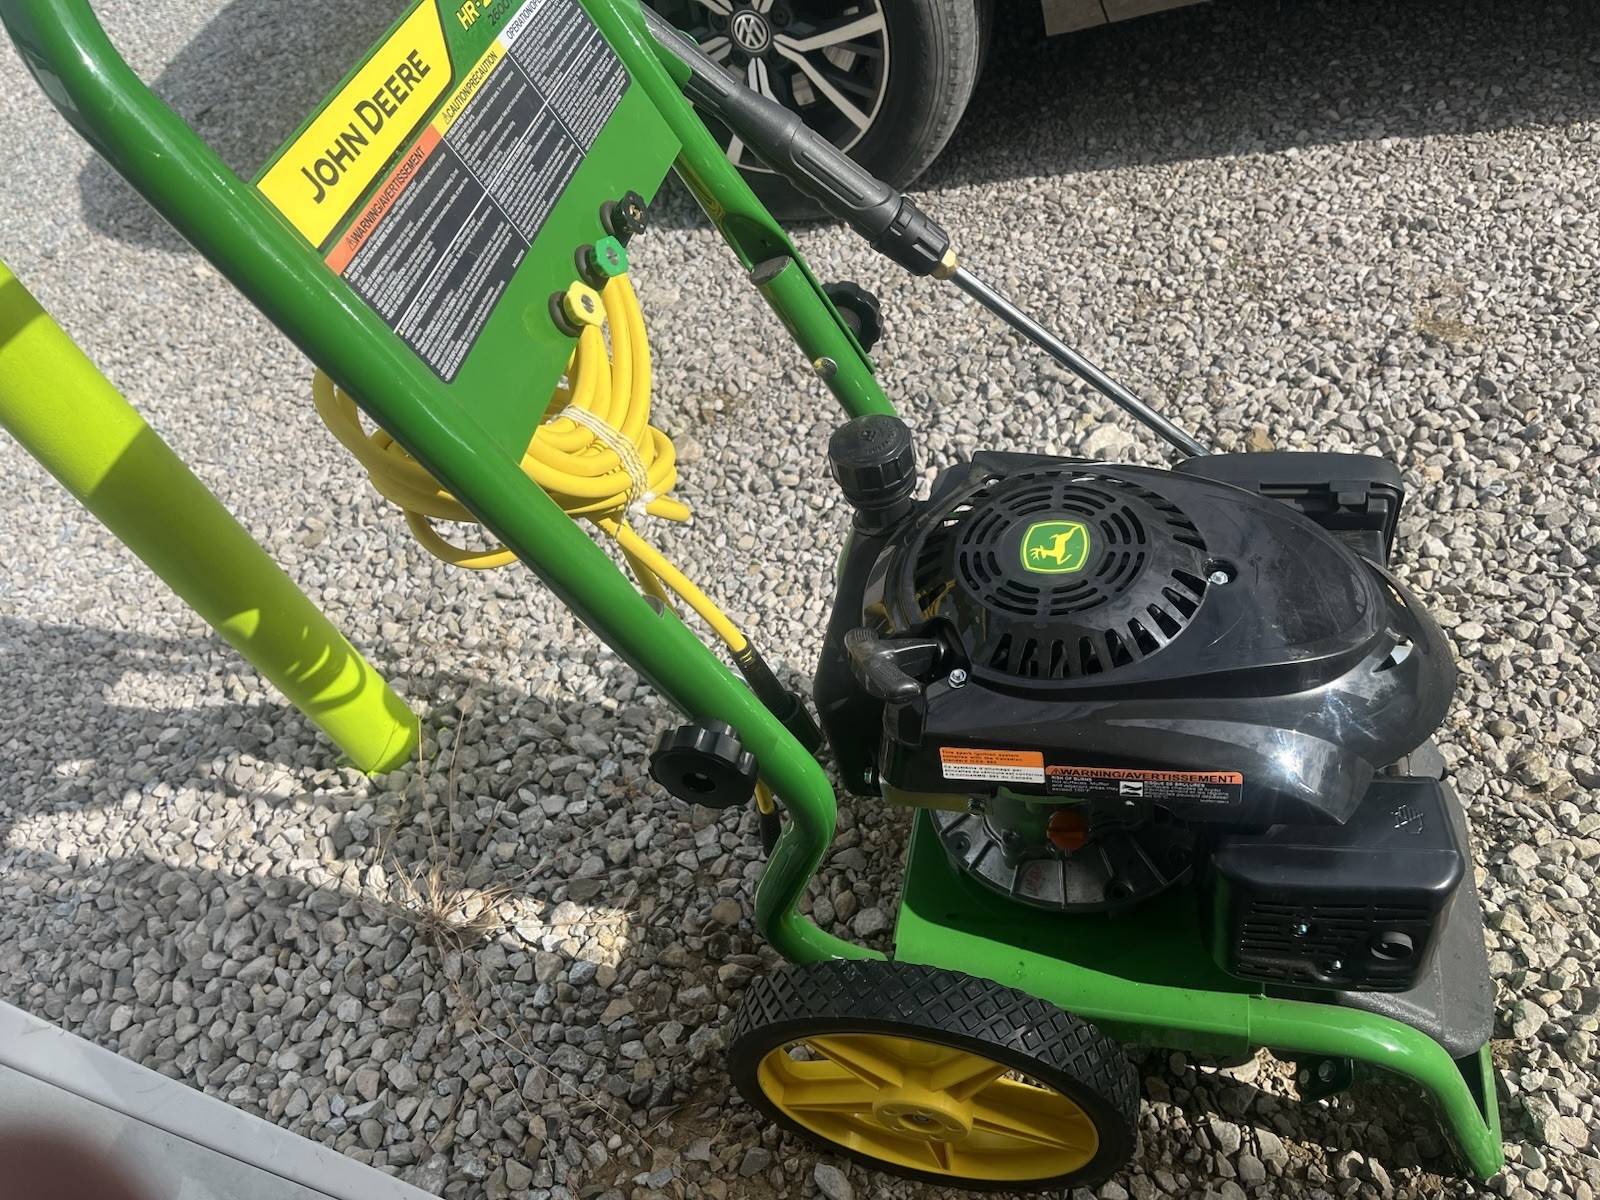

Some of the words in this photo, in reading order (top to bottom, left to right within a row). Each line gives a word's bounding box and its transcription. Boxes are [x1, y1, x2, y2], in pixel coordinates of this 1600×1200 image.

[447, 51, 498, 118] CAUTION/PRÉCAUTION
[301, 123, 369, 205] JOHN
[354, 48, 431, 135] DEERE
[352, 146, 425, 245] WARNING/AVERTISSEMENT
[1060, 768, 1236, 783] WARNING/AVERTISSEMENT
